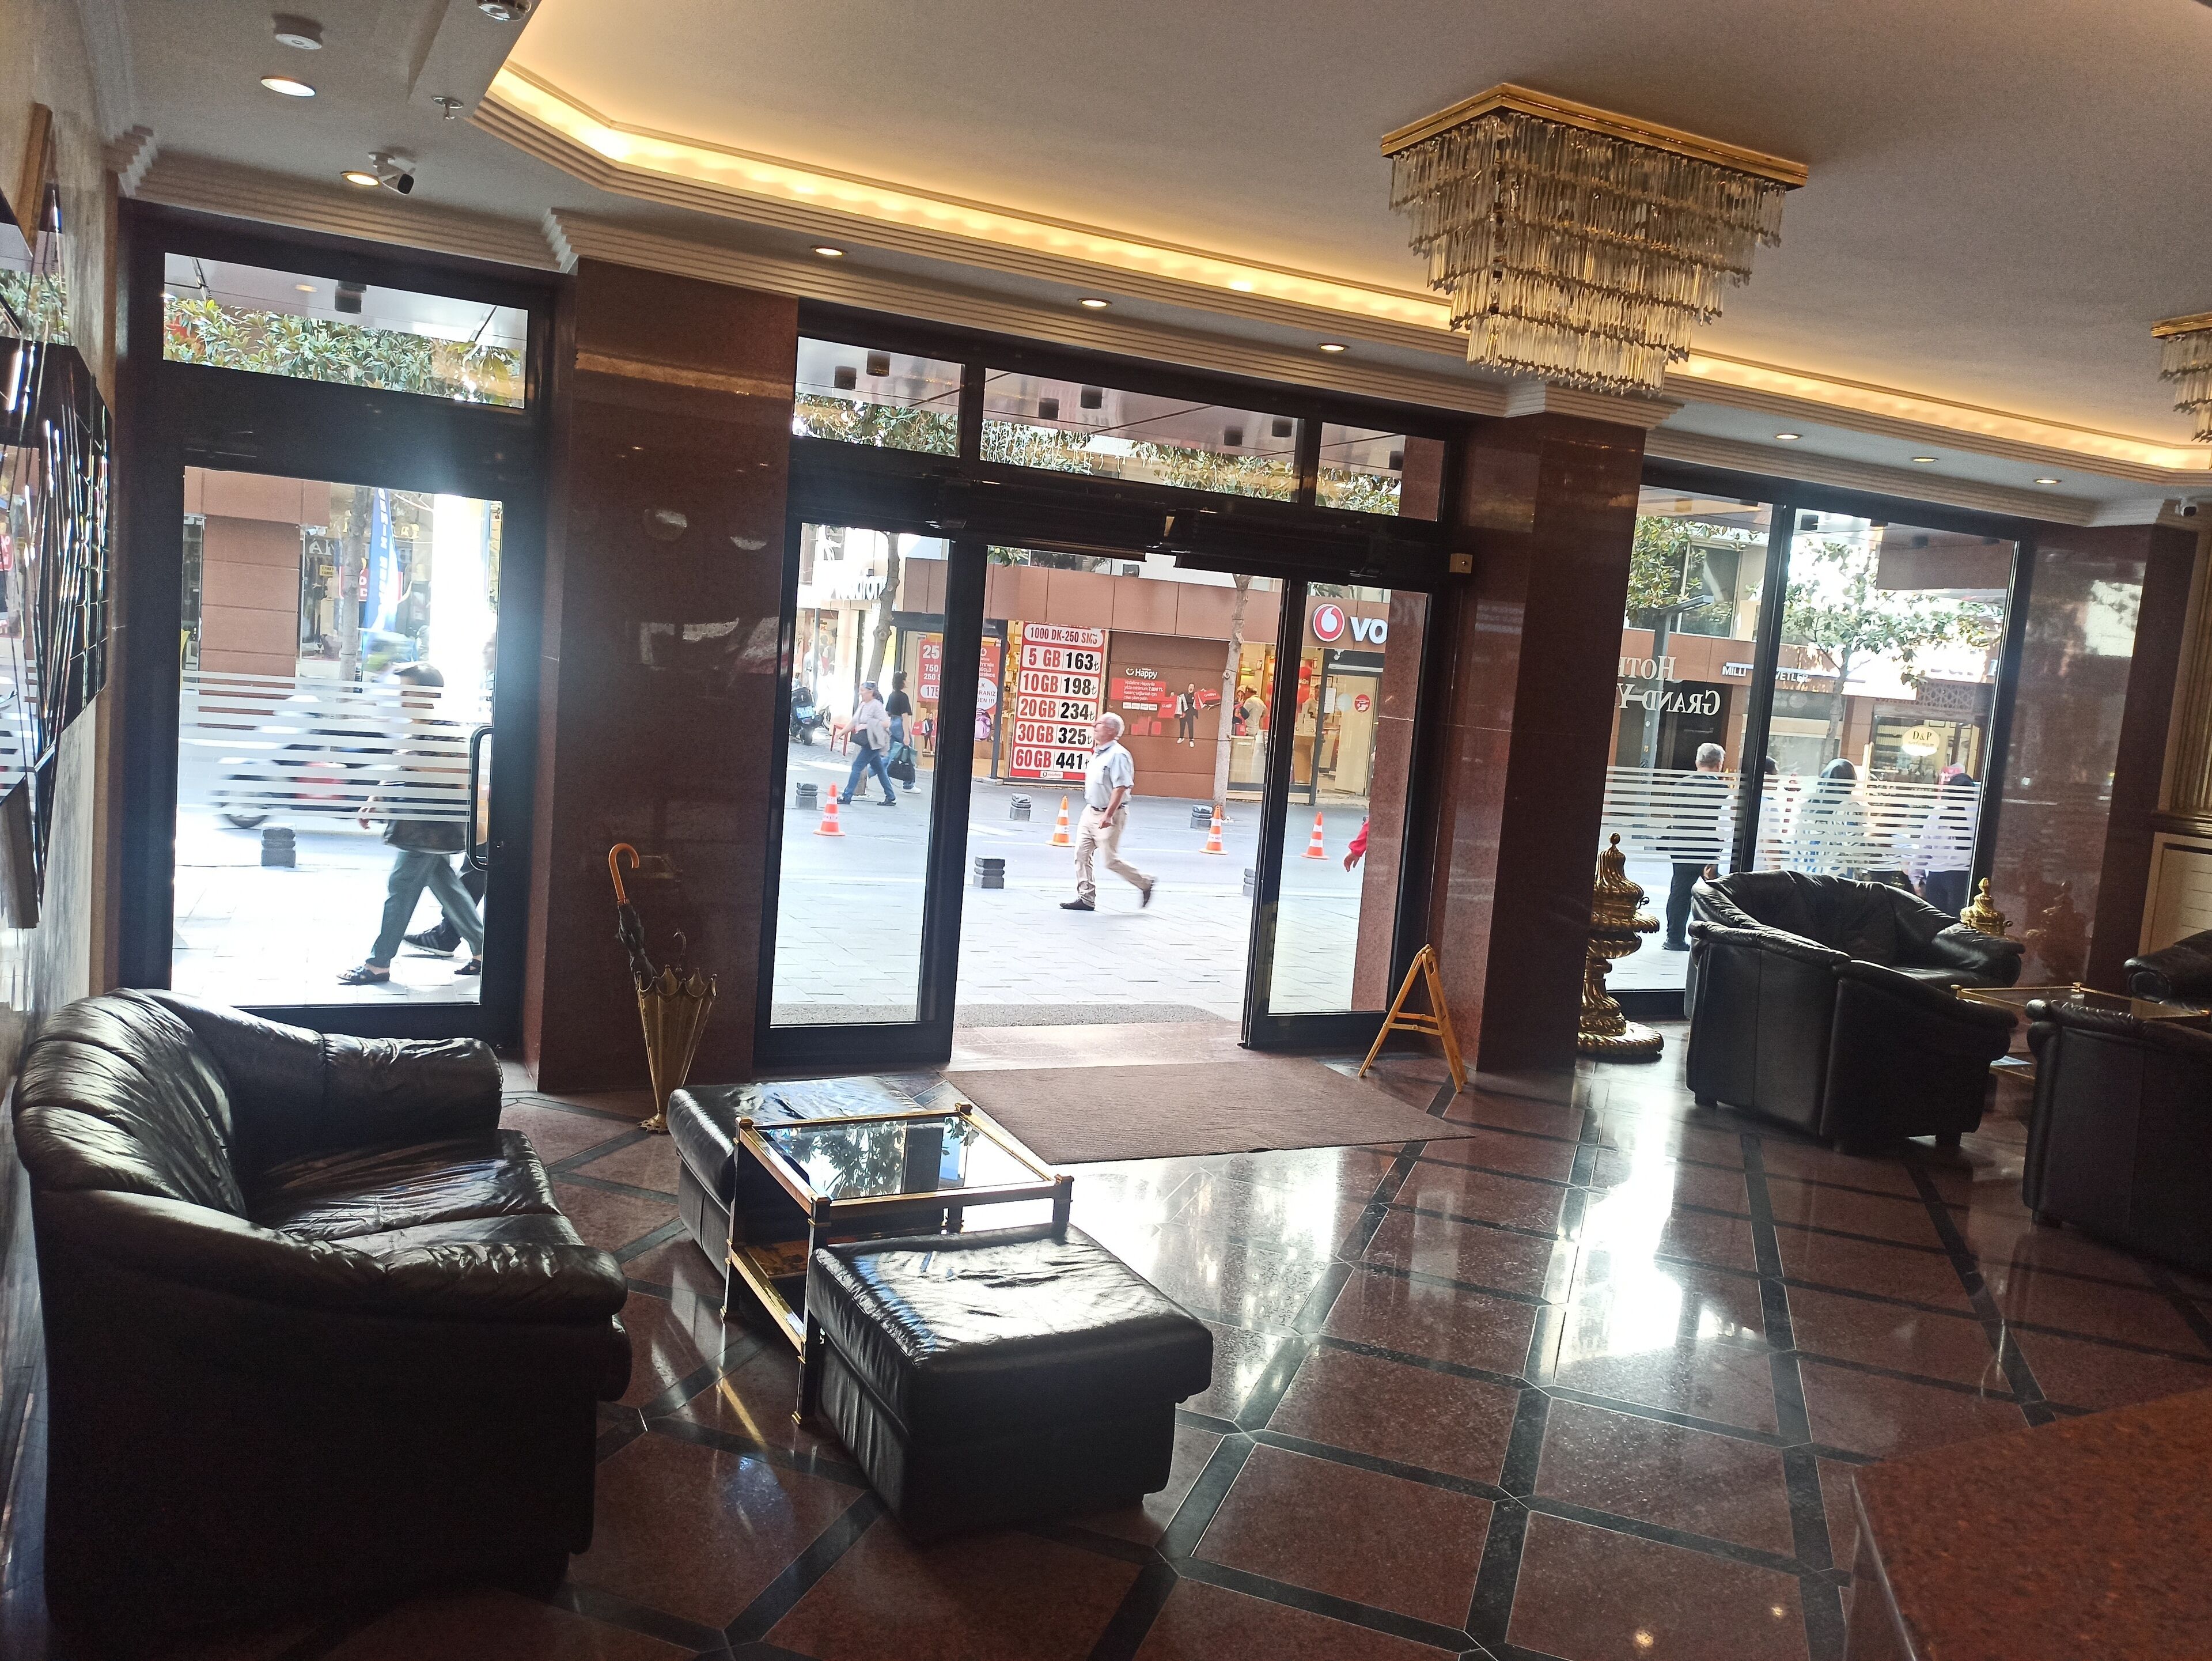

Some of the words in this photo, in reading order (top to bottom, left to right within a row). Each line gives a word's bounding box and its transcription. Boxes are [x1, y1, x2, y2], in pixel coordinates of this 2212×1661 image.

[1031, 627, 1048, 640] 1000
[1051, 629, 1079, 642] DK-250
[922, 644, 940, 659] 25
[1029, 648, 1037, 665] 5
[1043, 649, 1060, 667] GB
[925, 664, 938, 672] 750
[1135, 668, 1158, 680] Happy
